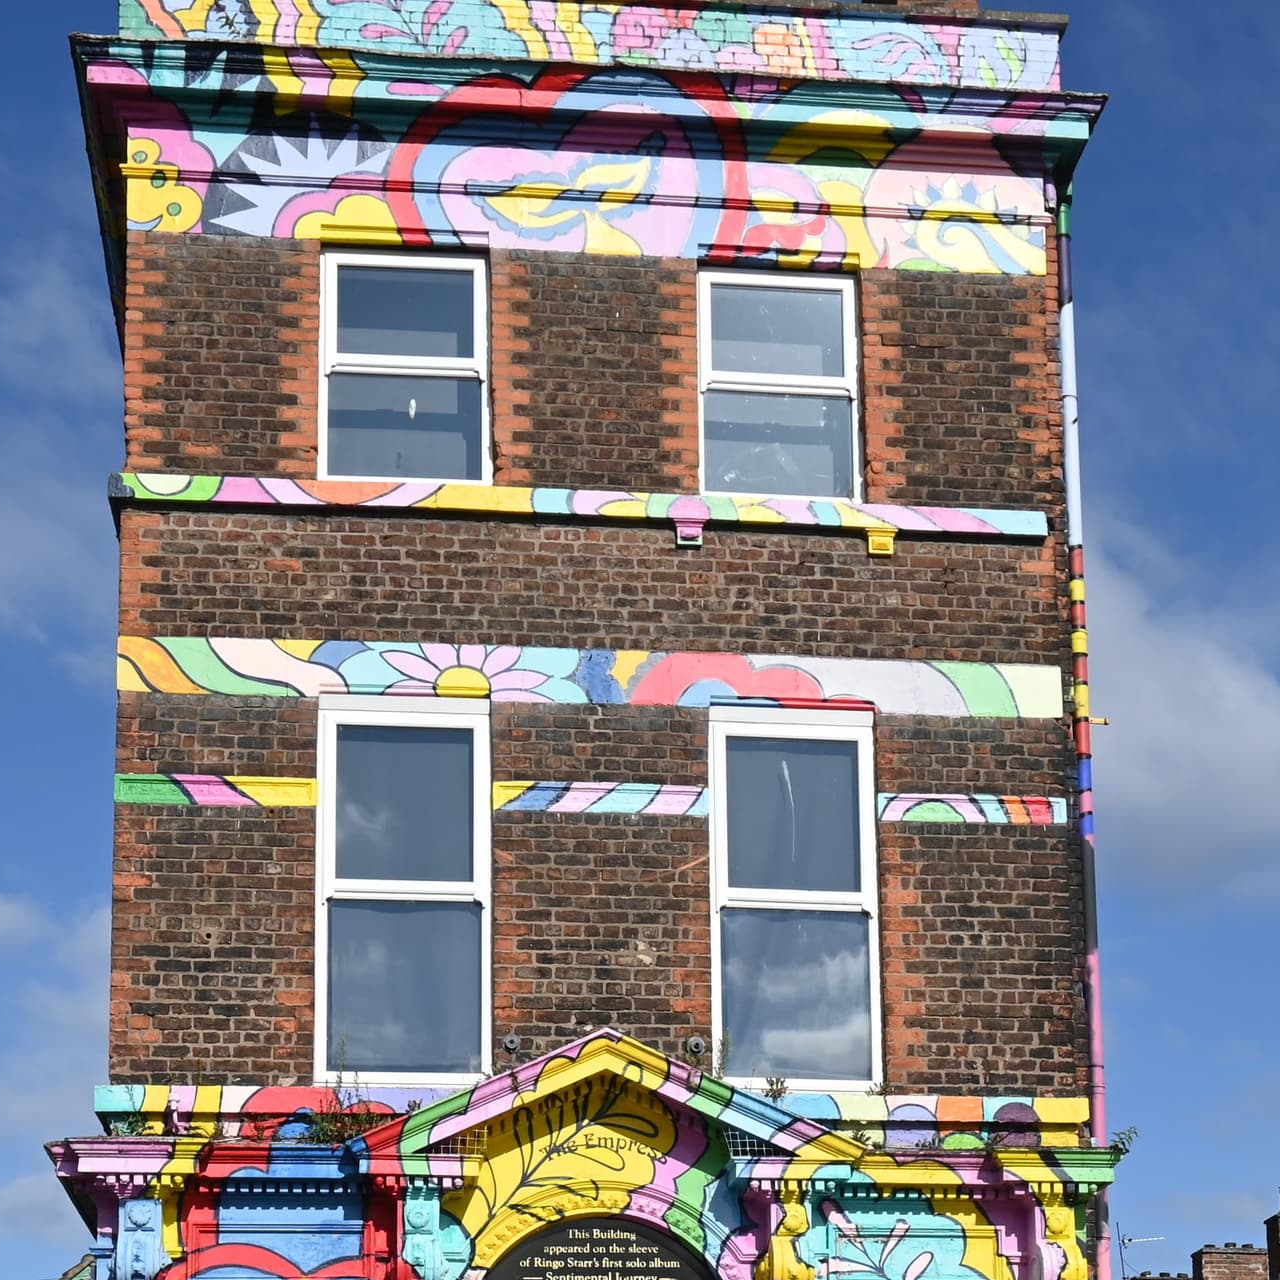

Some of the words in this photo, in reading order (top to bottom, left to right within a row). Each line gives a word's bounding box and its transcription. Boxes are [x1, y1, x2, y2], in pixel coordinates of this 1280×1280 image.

[583, 1133, 668, 1165] Empress
[568, 1229, 590, 1239] This
[592, 1229, 637, 1241] Building
[543, 1243, 590, 1255] appeared
[609, 1243, 626, 1253] the
[628, 1243, 659, 1253] sleeve
[519, 1257, 531, 1267] of
[534, 1257, 565, 1269] Ringo
[567, 1257, 600, 1268] Starr's
[602, 1257, 623, 1268] first
[625, 1257, 647, 1268] solo
[648, 1257, 680, 1268] album
